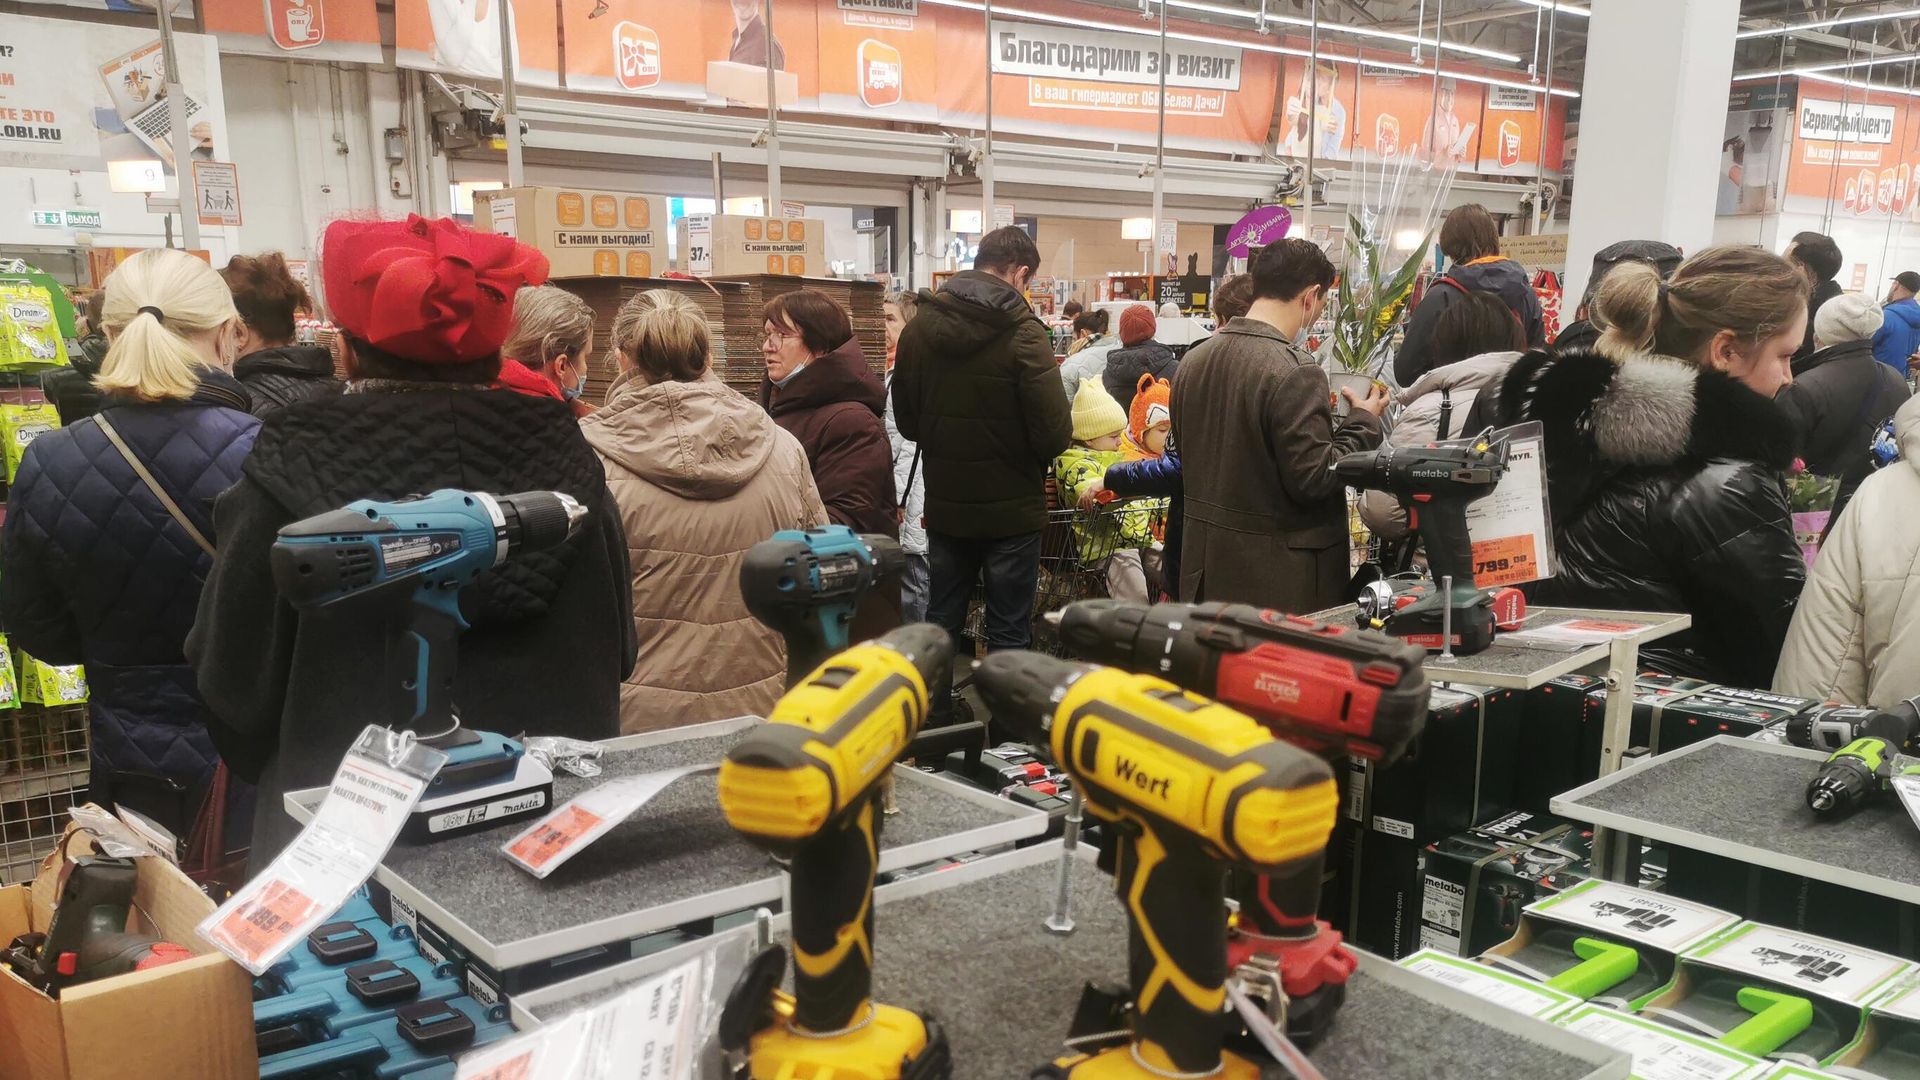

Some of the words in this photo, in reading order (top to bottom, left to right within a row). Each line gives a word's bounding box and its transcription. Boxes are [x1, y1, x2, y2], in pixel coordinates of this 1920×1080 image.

[999, 31, 1141, 76] Благодарим
[1176, 54, 1235, 80] визит
[1034, 83, 1041, 99] В
[1044, 87, 1069, 101] ваш
[1071, 88, 1140, 107] гипермаркет
[1194, 94, 1221, 112] Дача!
[21, 109, 55, 124] ЭТО
[1803, 107, 1861, 135] Сервисный
[1861, 116, 1892, 139] центр
[67, 213, 100, 226] ВЫХОД
[558, 233, 566, 245] С
[569, 233, 598, 245] нами
[601, 233, 651, 246] выгодно!
[745, 243, 751, 251] С
[751, 244, 771, 252] нами
[772, 244, 805, 253] выгодно!
[1161, 286, 1172, 297] 20
[1412, 469, 1449, 479] metabo
[1115, 754, 1169, 801] Wert
[503, 799, 540, 814] makita
[1425, 878, 1464, 896] metabo
[391, 894, 415, 919] metabo
[1629, 897, 1677, 913] UN3481
[1791, 942, 1847, 960] UN3481
